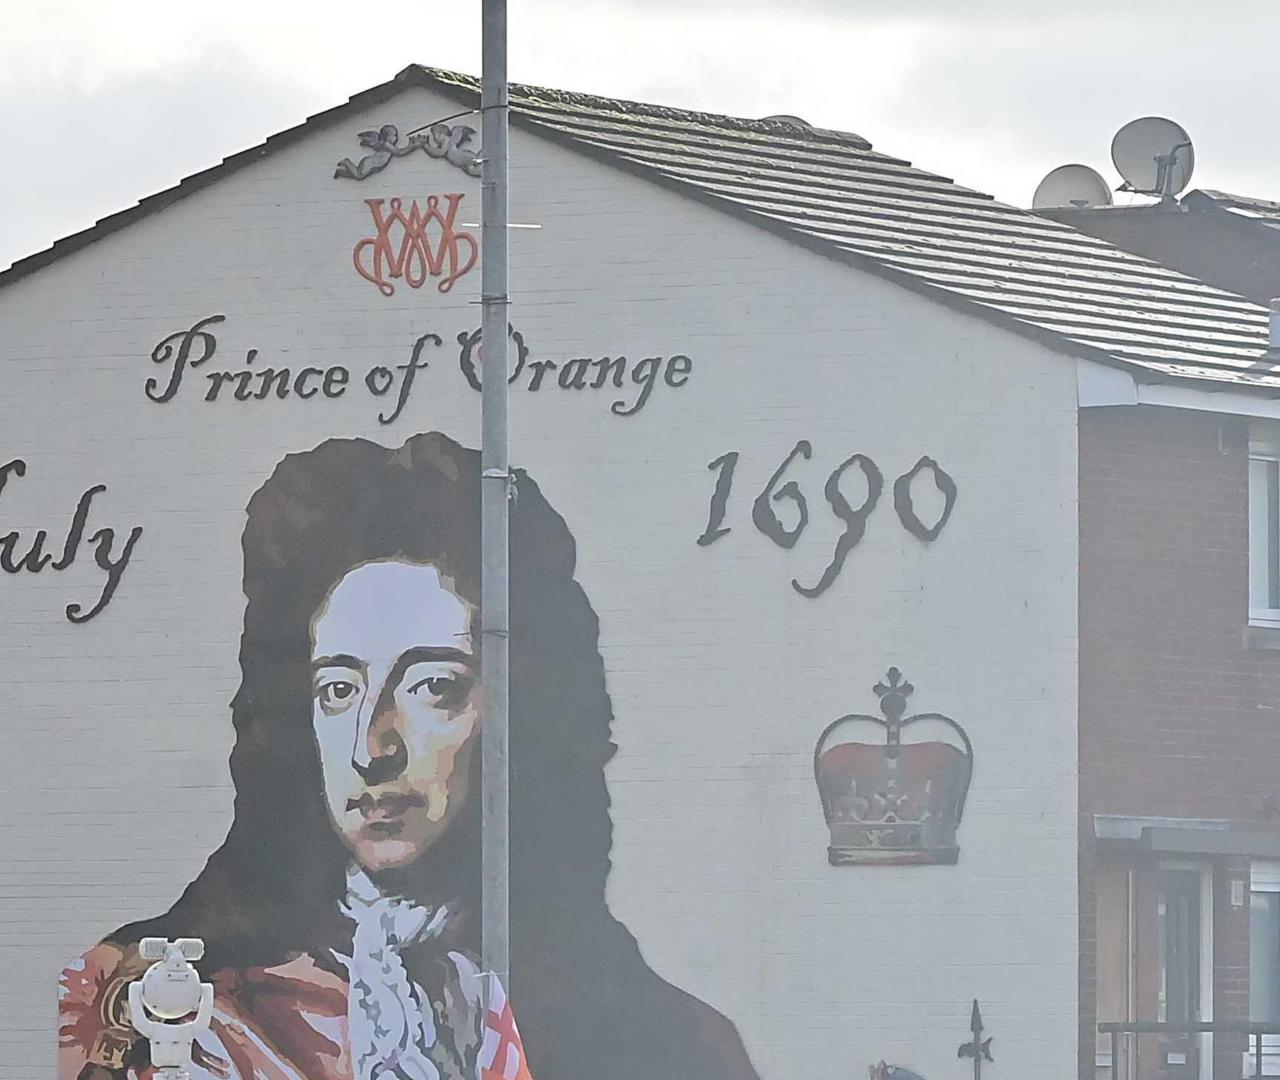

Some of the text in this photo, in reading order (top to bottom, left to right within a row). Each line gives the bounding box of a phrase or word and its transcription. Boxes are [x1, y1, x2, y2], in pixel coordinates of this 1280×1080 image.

[145, 315, 349, 404] Prince
[365, 334, 443, 424] of
[696, 439, 958, 599] 1690
